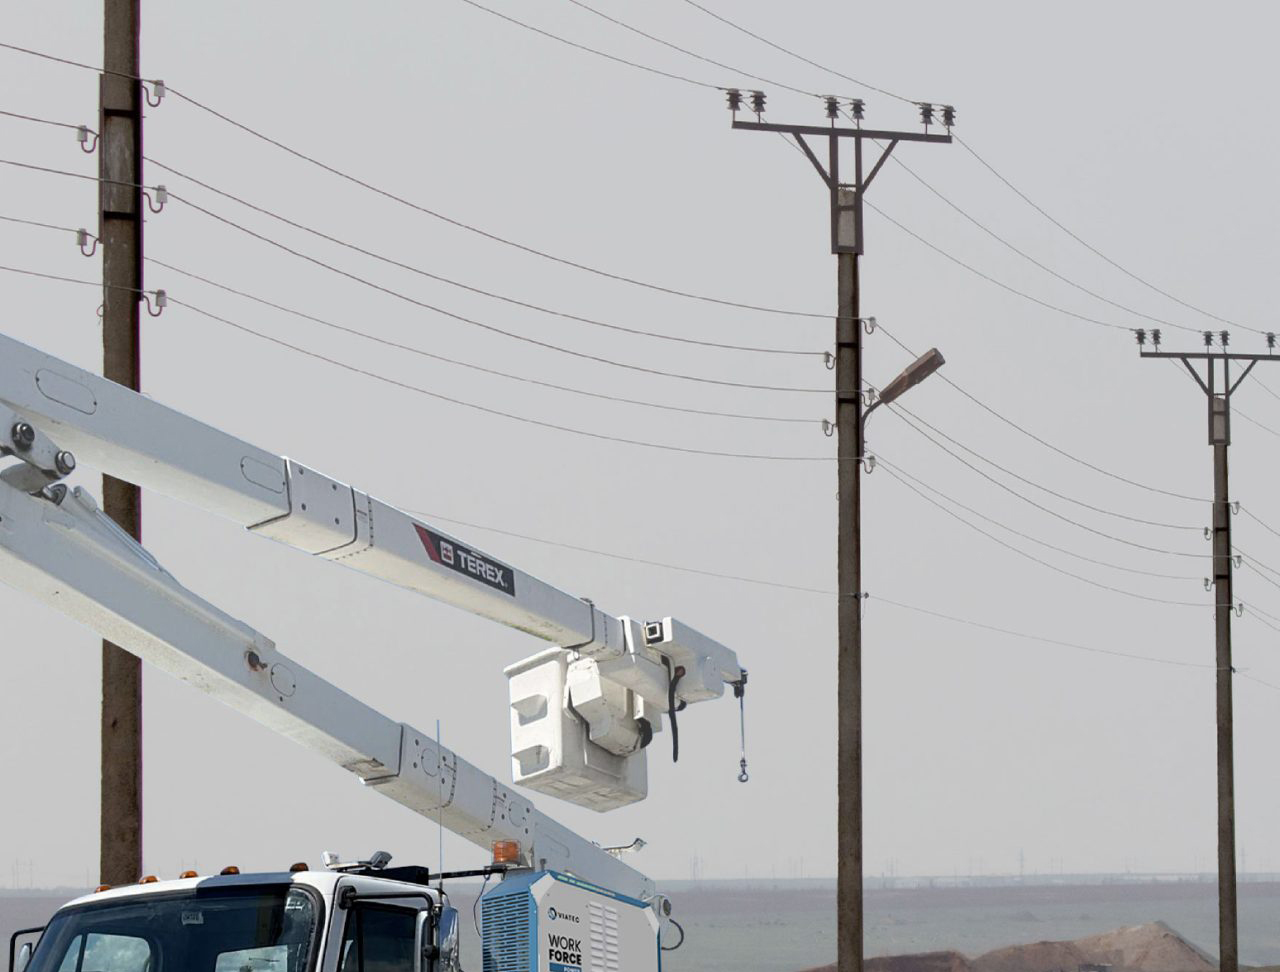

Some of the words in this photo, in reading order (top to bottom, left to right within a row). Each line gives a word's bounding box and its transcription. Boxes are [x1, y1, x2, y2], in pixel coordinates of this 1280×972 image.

[457, 550, 504, 586] TEREX
[558, 912, 580, 923] VIATEC
[548, 933, 581, 953] WORK
[549, 948, 582, 966] FORCE
